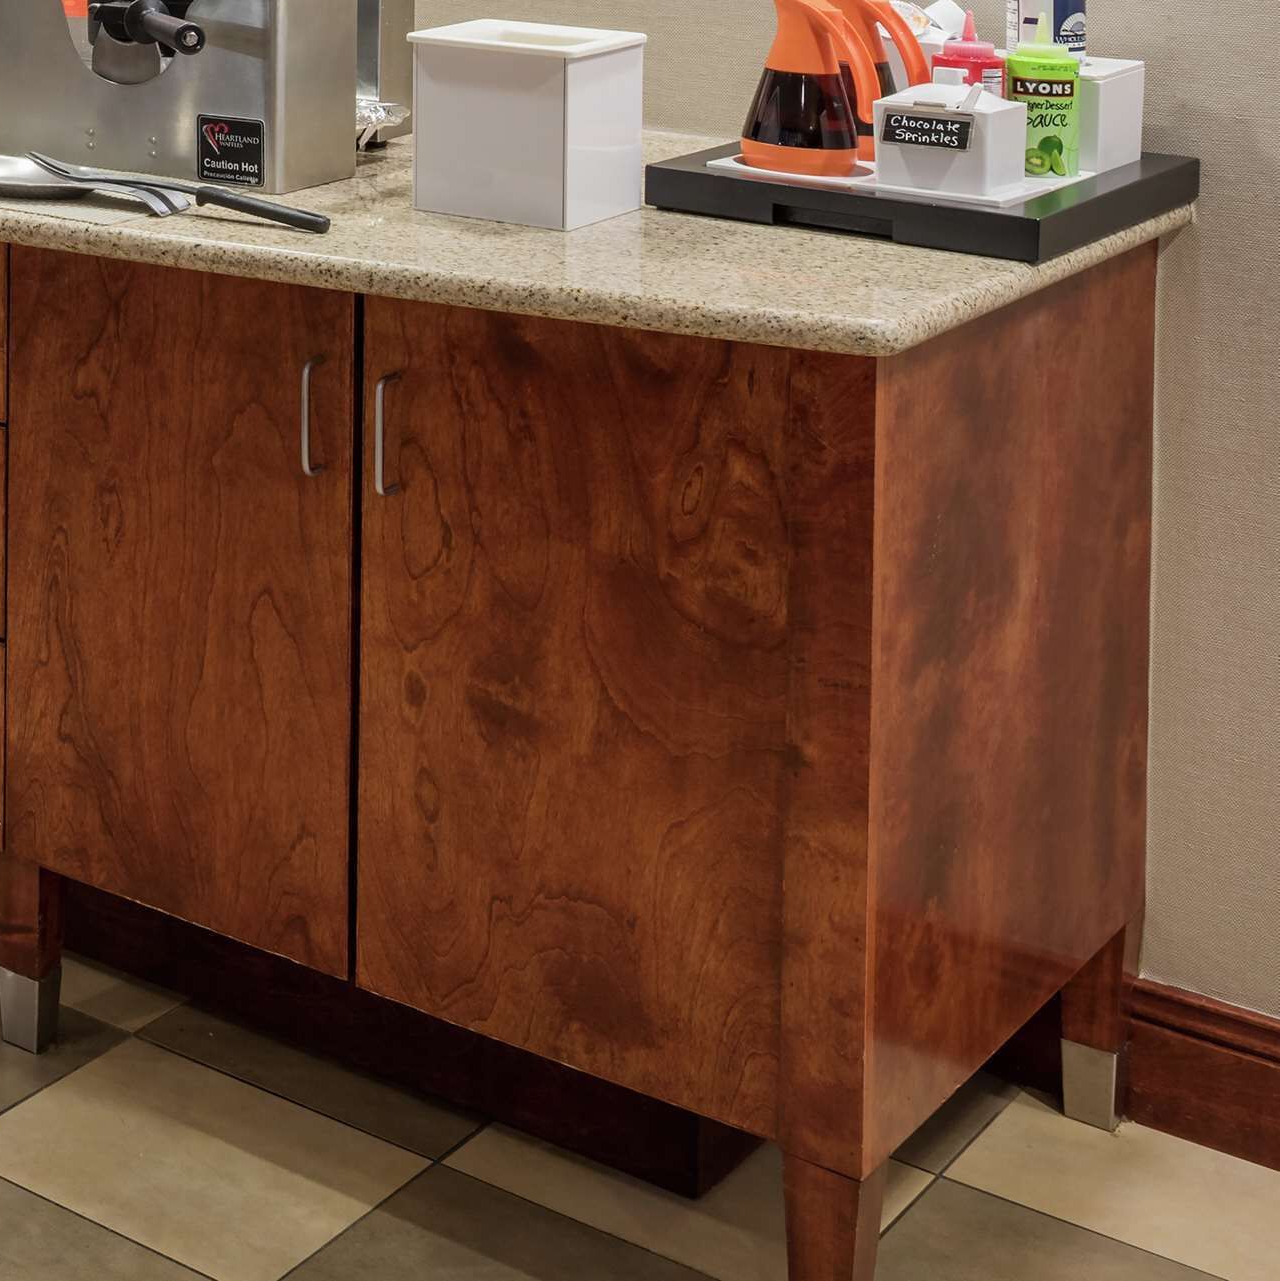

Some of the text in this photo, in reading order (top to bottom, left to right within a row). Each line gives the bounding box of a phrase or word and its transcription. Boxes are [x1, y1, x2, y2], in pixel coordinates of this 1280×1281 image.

[1016, 81, 1072, 95] LYONS
[1045, 100, 1073, 111] Dessert
[891, 116, 960, 132] Chocolate
[215, 133, 259, 144] HEARTLAND
[895, 129, 958, 146] Sprinkles
[204, 158, 259, 173] Caution Hot
